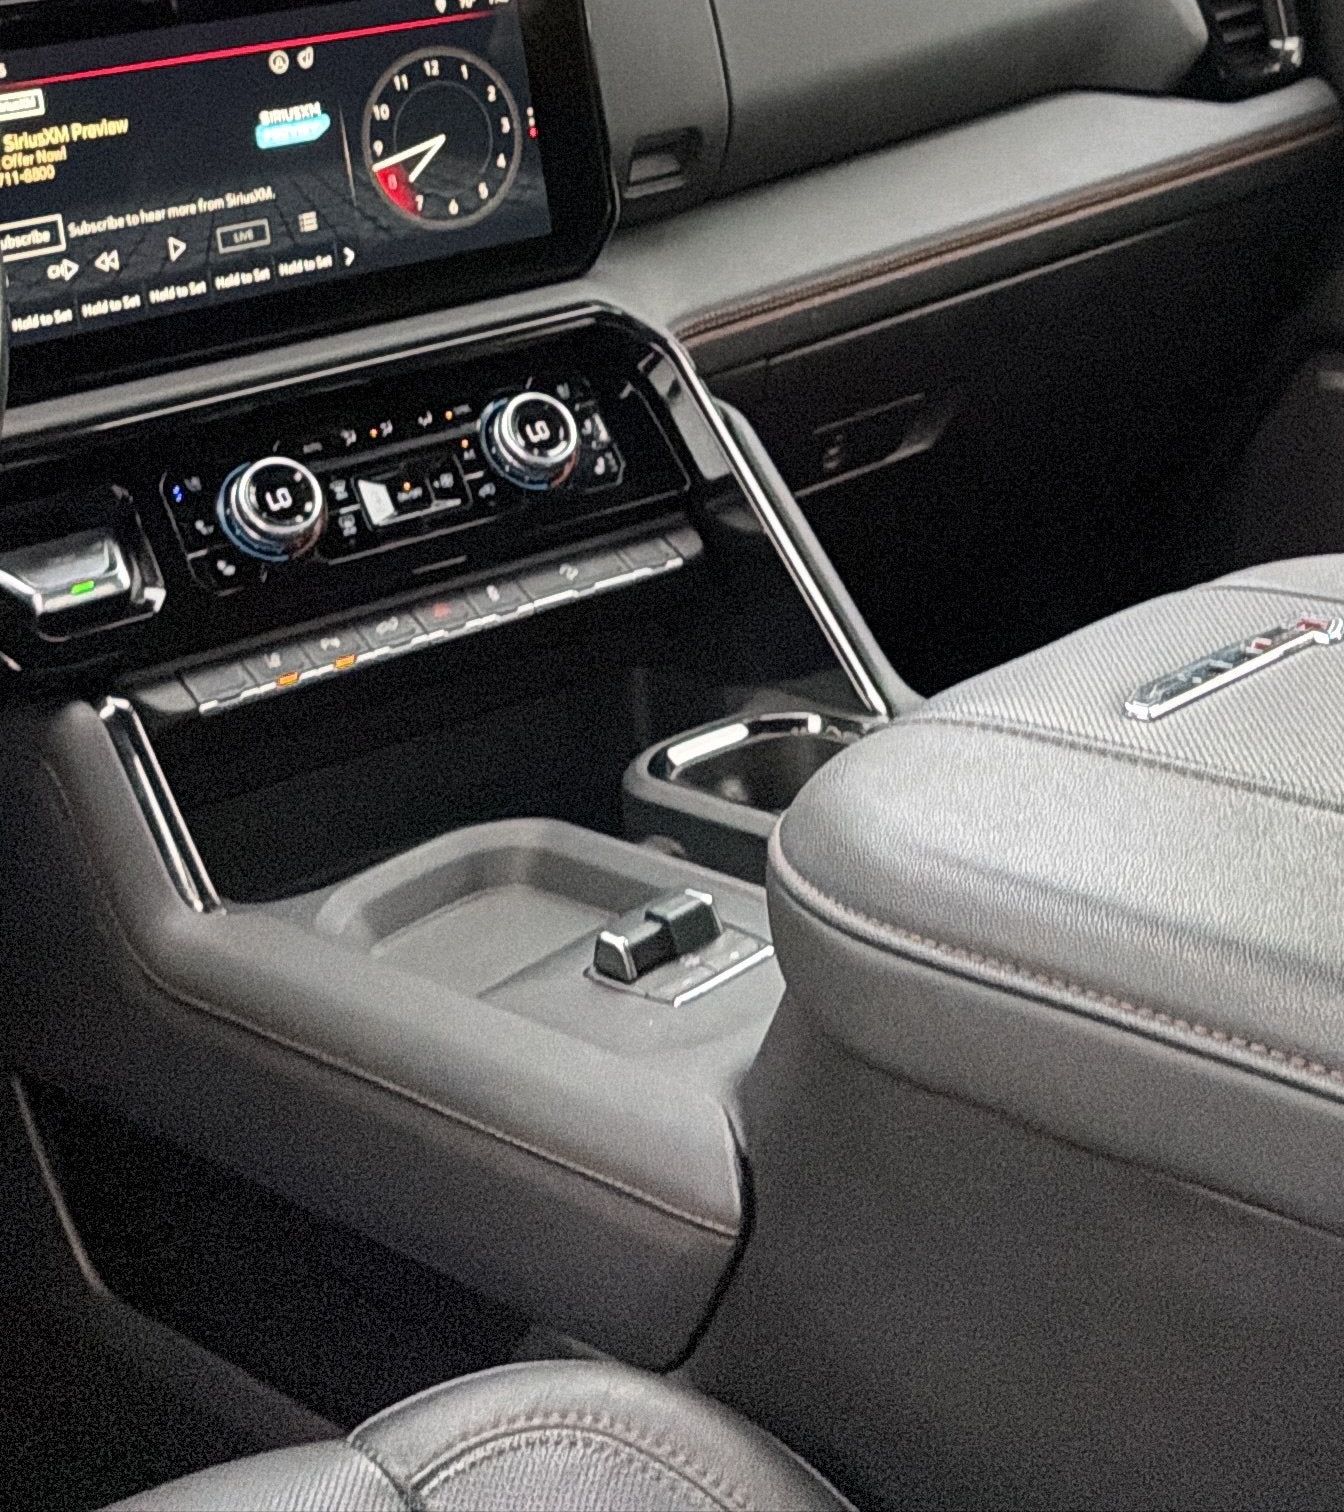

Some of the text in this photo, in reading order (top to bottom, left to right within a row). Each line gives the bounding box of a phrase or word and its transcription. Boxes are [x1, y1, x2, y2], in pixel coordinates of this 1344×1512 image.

[393, 73, 409, 92] 11
[372, 103, 390, 121] 10
[2, 124, 70, 153] SiriusXM
[70, 117, 129, 142] Preview
[67, 213, 125, 238] Subscribe
[125, 212, 139, 226] to
[139, 207, 166, 224] hear
[167, 200, 197, 218] more
[197, 196, 225, 214] from
[0, 228, 51, 252] ubscribe
[277, 258, 304, 277] Hold
[215, 272, 241, 290] Hold
[149, 287, 176, 304] Hold
[81, 300, 109, 318] Hold
[11, 314, 39, 333] Hold
